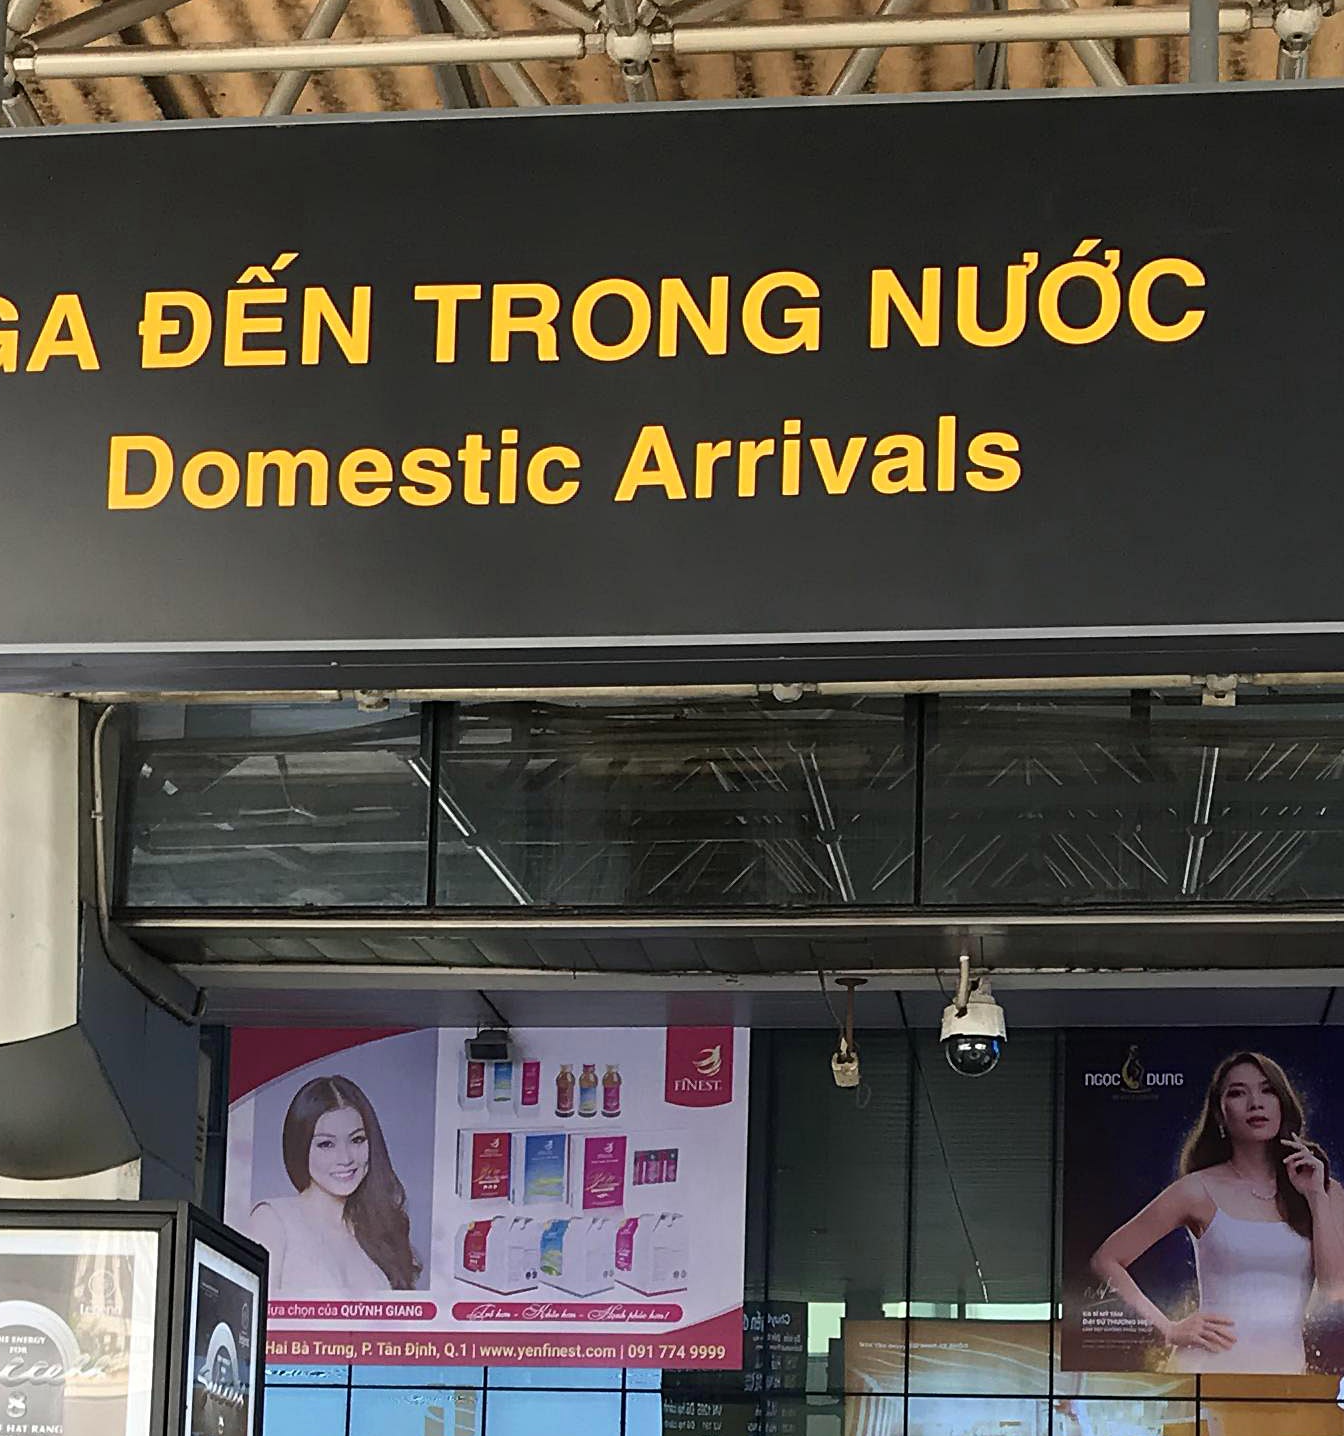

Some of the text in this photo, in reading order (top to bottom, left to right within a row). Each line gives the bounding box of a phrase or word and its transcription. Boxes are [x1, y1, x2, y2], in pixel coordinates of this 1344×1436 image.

[138, 252, 373, 370] ĐẾN
[414, 270, 822, 367] TRONG
[868, 238, 1206, 350] NƯỚC
[106, 413, 1022, 512] Domestic Arrivals
[1146, 1073, 1184, 1086] DUNG
[287, 1303, 316, 1319] chọn
[317, 1303, 338, 1317] của
[341, 1301, 381, 1319] QUỲNH
[385, 1305, 423, 1317] GIANG
[265, 1339, 726, 1363] Hai Bà Trưng, P. Tân Định, Q.1 www.yenfinest.com 091 774 9999
